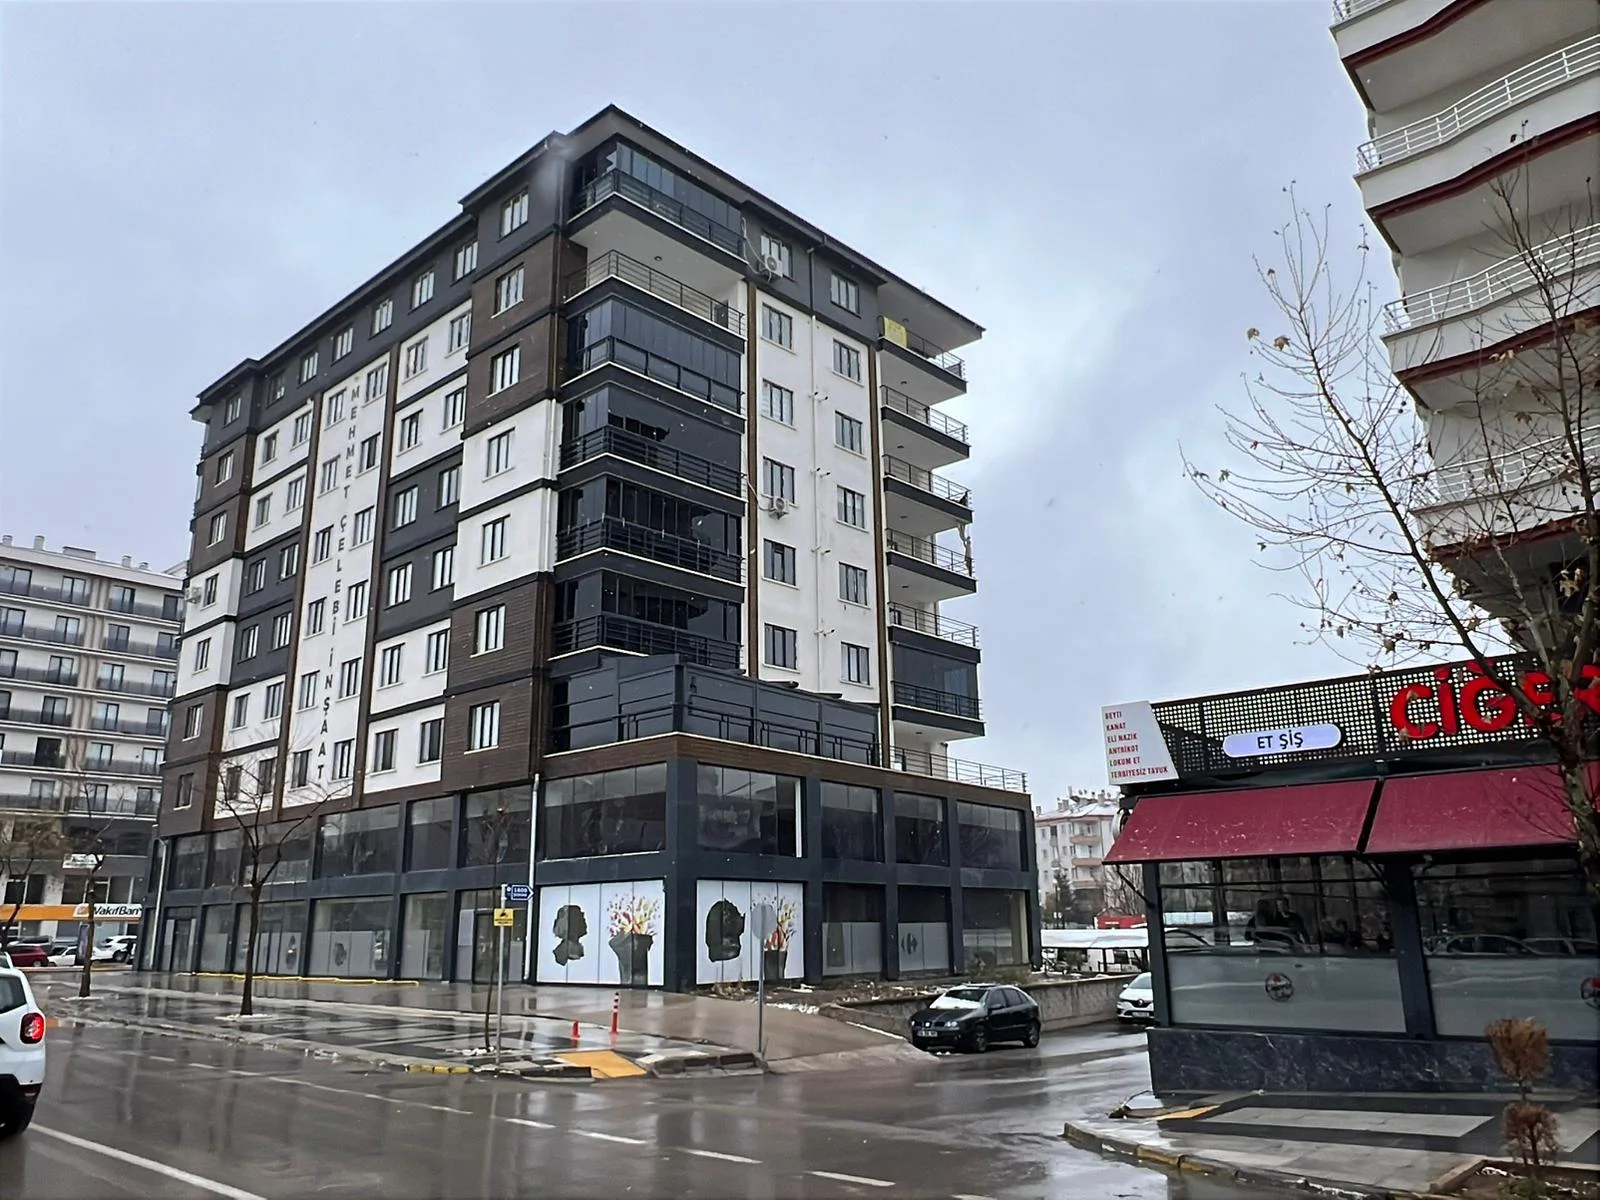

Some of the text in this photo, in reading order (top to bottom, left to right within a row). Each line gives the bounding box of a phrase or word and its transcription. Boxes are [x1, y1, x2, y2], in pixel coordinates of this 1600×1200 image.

[317, 386, 360, 780] MEHMET ÇELEBİ İNŞAAT
[1257, 729, 1304, 750] ET ŞİŞ
